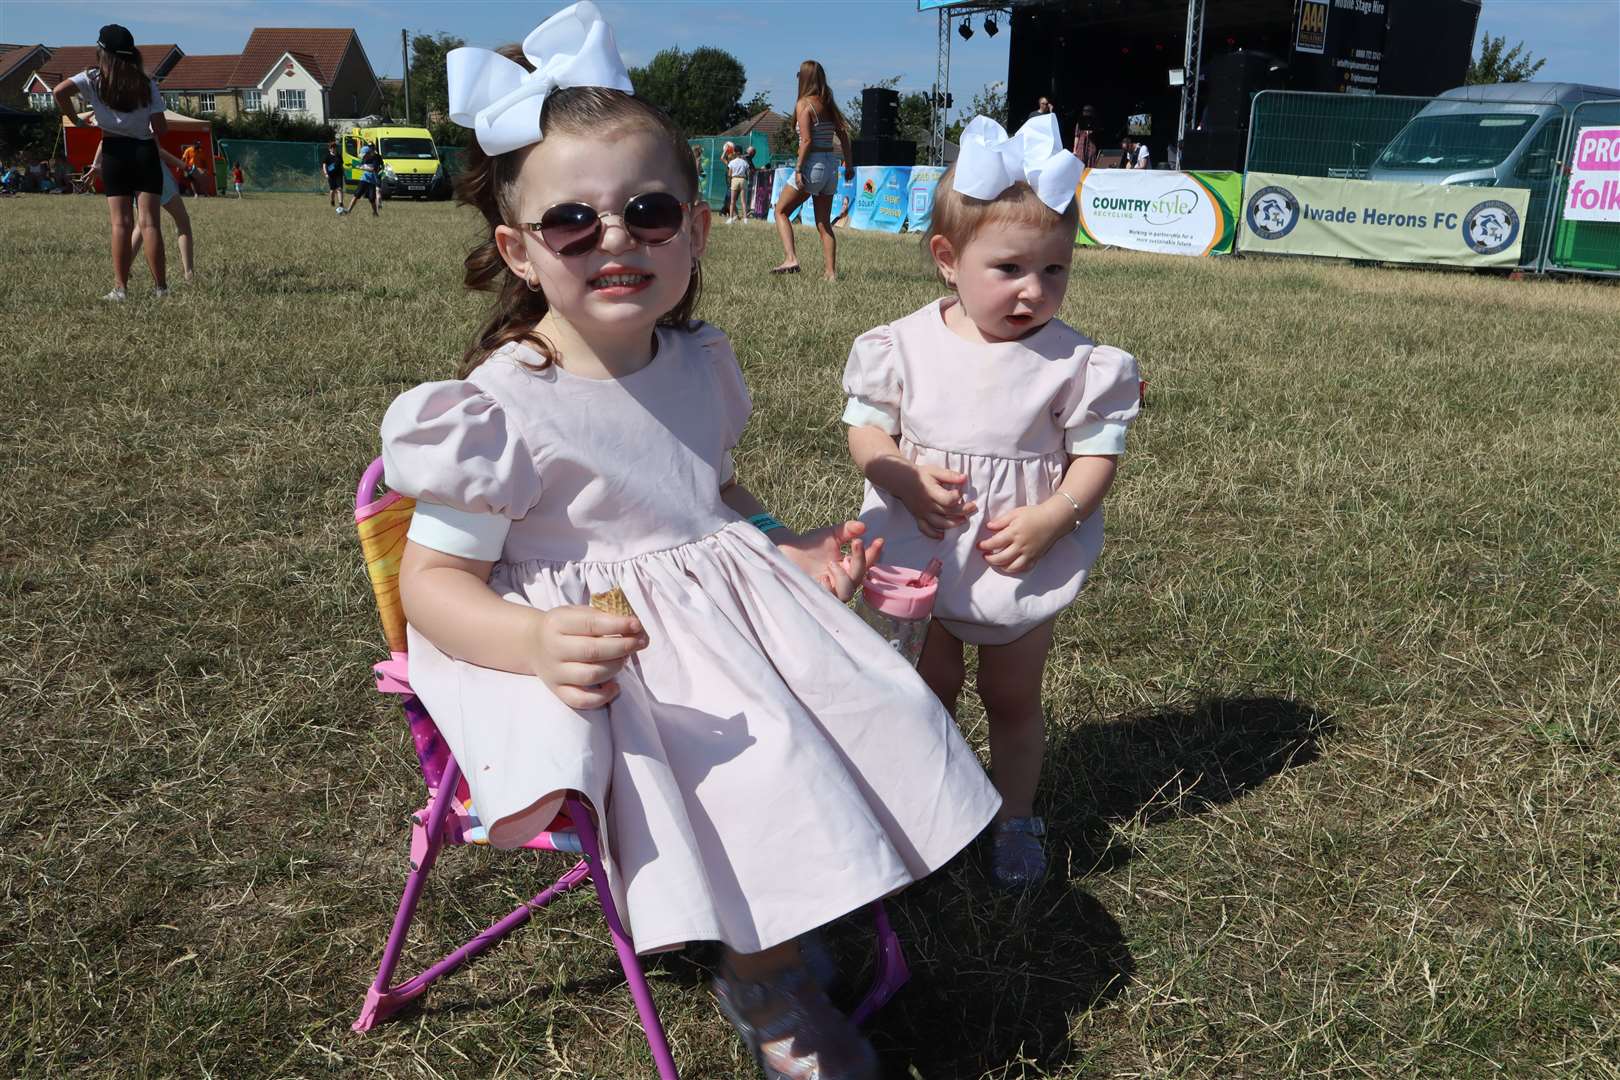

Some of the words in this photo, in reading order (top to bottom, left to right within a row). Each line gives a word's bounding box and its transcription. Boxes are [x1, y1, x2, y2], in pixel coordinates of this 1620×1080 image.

[1355, 0, 1372, 15] Stage
[1372, 0, 1385, 14] Hire
[1093, 211, 1134, 219] RECYCLING
[1303, 203, 1357, 224] Iwade
[1362, 207, 1427, 228] Herons
[1433, 212, 1458, 230] FC
